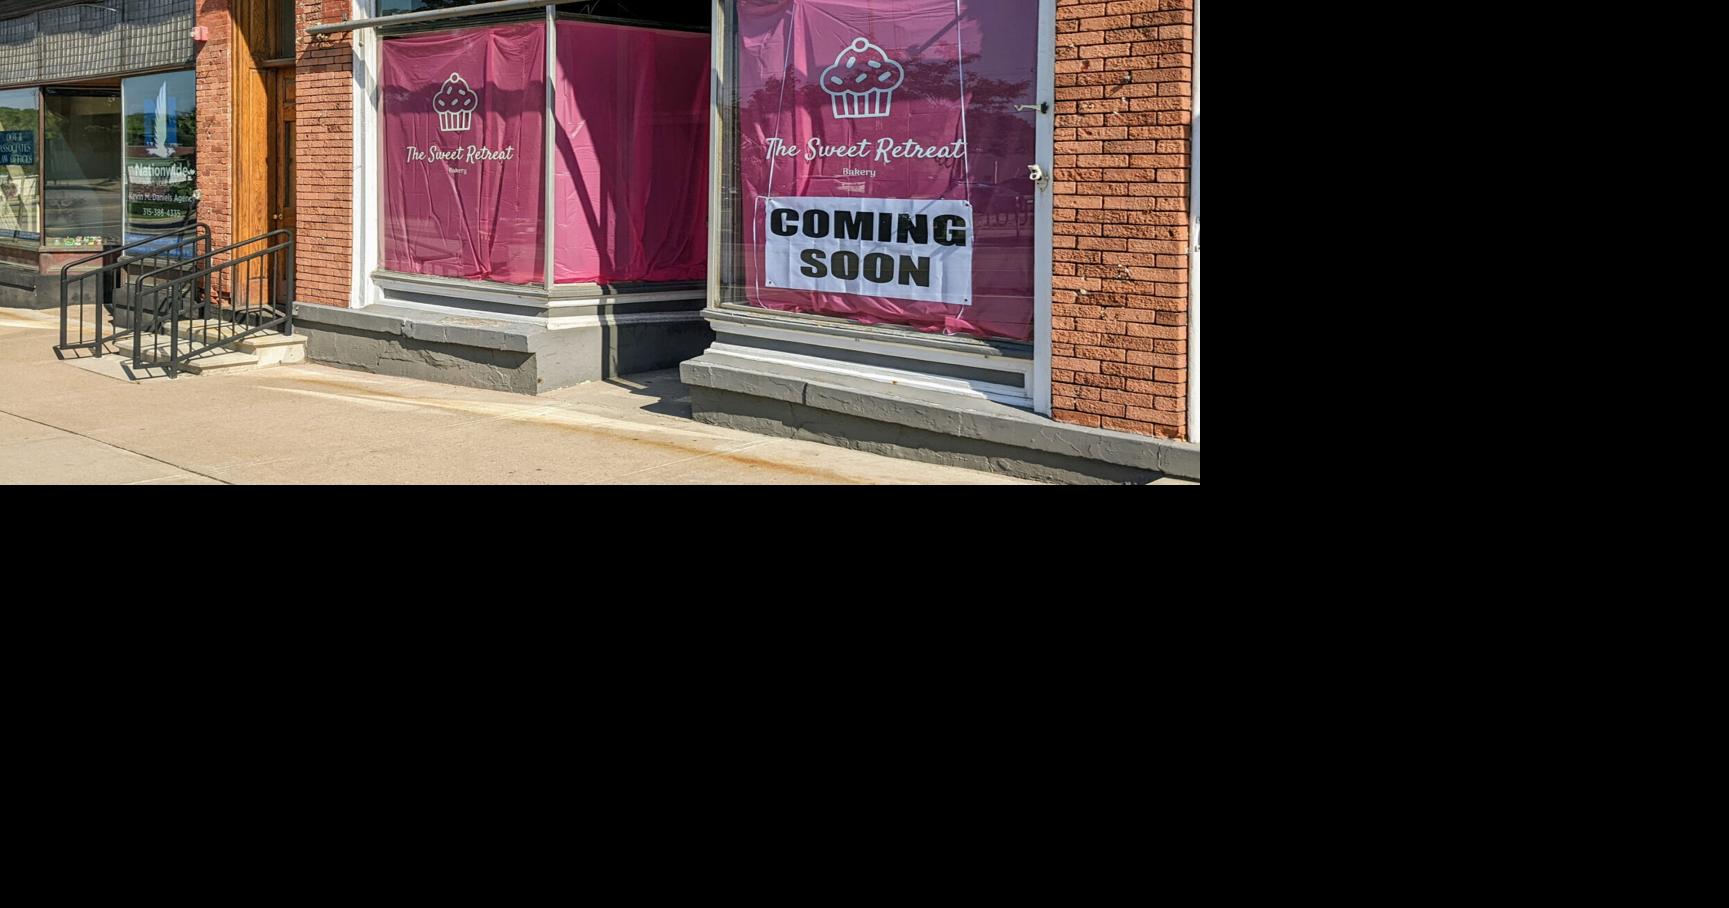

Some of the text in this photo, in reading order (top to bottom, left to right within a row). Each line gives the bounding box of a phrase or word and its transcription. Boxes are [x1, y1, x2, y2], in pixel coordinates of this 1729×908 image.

[406, 145, 515, 164] The Sweet Retreat
[765, 137, 968, 163] The Sweet Retreat
[134, 162, 188, 177] Nationwide
[448, 167, 468, 175] Bakery
[842, 167, 876, 177] Bakery
[152, 193, 173, 202] Daniels
[770, 208, 967, 247] COMING
[800, 248, 931, 288] SOON
